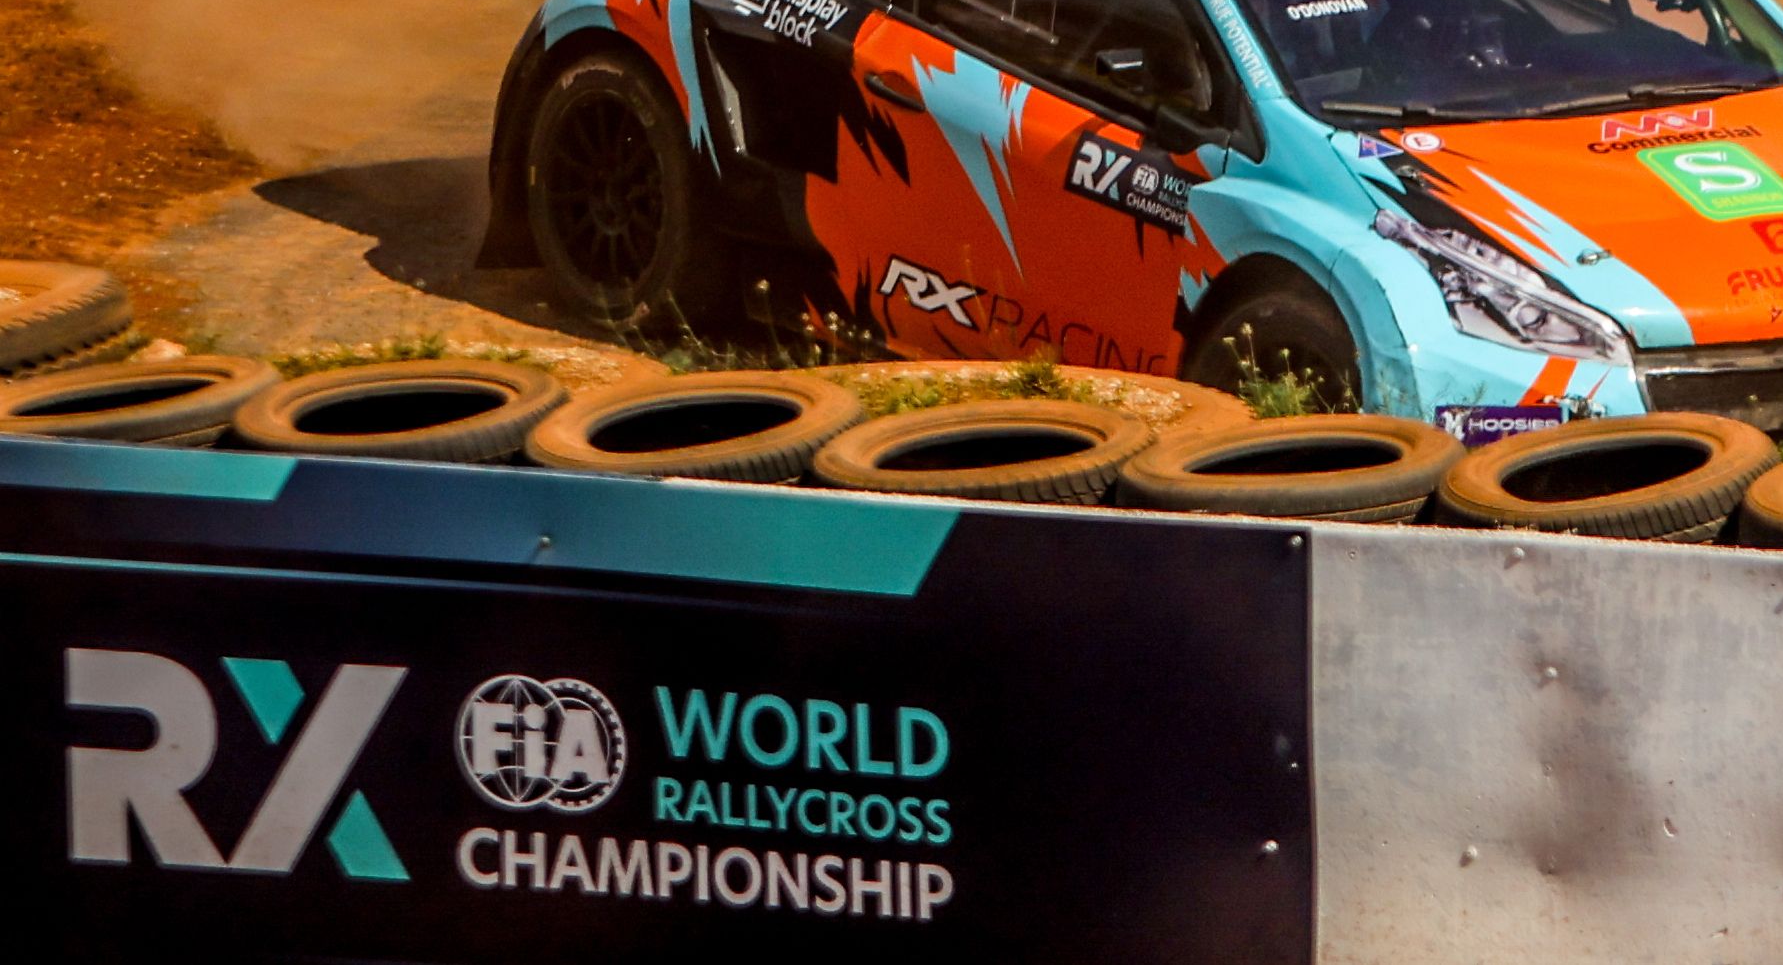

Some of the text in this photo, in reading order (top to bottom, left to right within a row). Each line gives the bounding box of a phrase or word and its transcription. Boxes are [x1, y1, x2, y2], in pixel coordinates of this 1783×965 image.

[763, 0, 817, 48] block
[1071, 140, 1133, 201] RX
[1587, 125, 1763, 154] Commercial
[65, 647, 411, 881] RX
[654, 684, 951, 779] WORLD
[652, 775, 953, 844] RALLYCROSS
[455, 826, 956, 922] CHAMPIONSHIP
